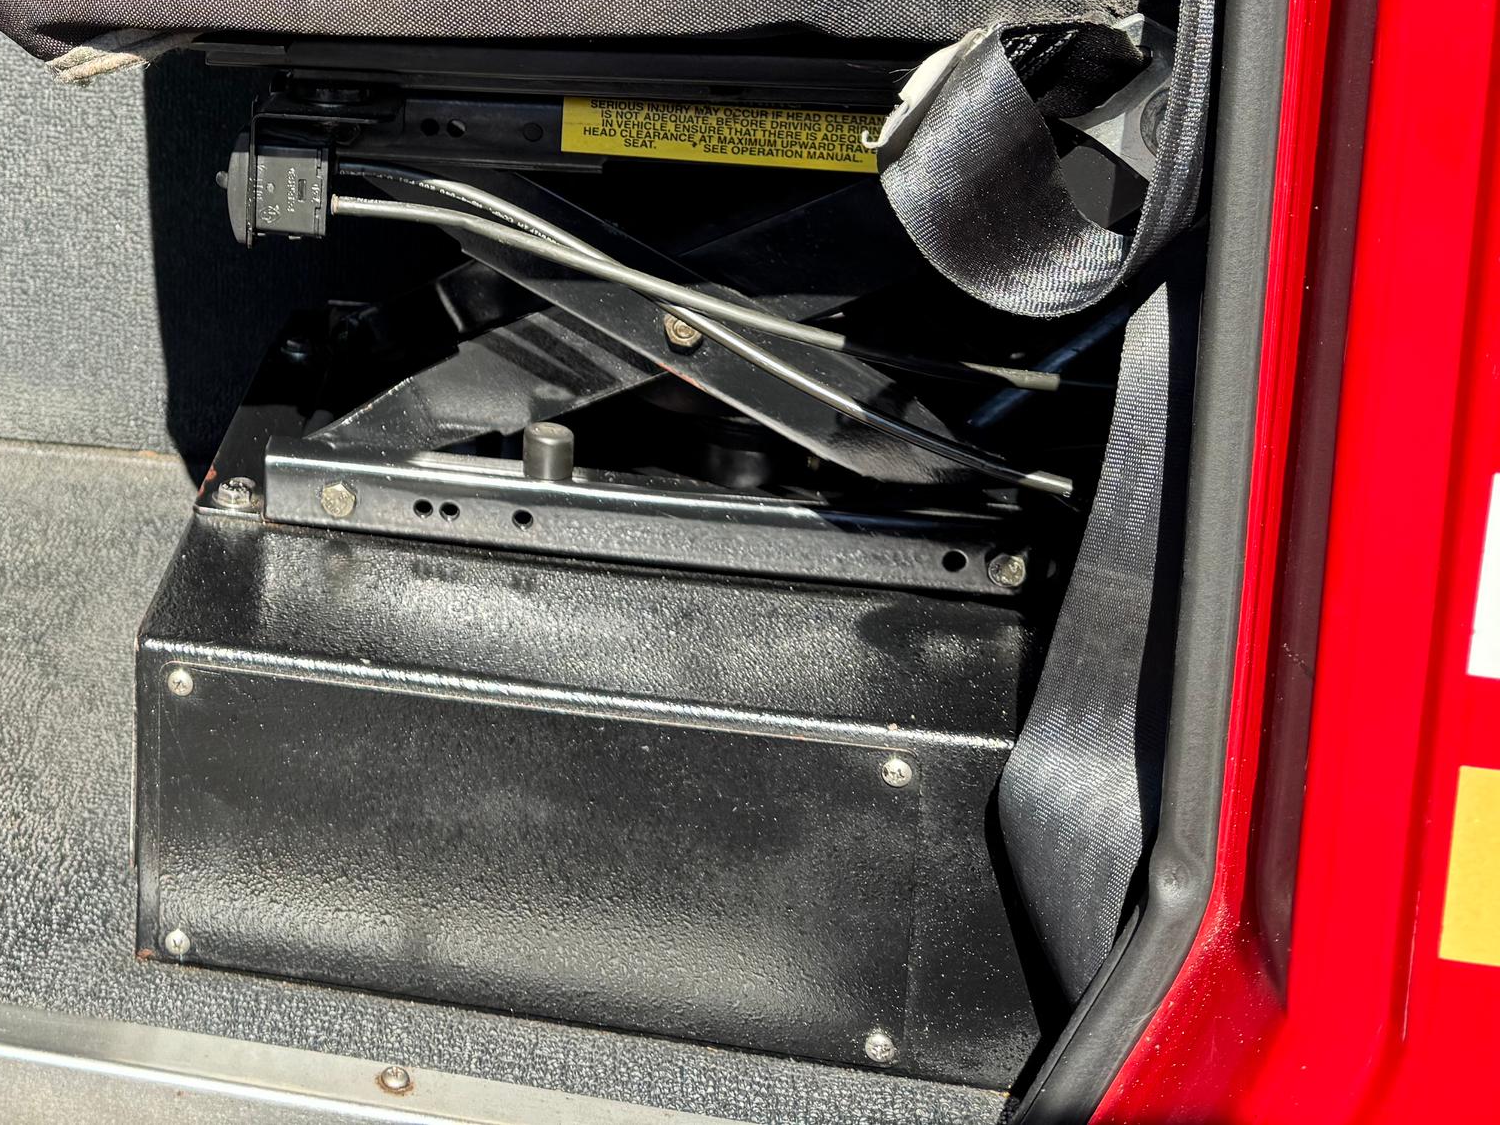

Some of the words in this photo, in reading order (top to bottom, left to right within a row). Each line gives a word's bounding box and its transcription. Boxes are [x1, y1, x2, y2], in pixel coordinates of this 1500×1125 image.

[591, 100, 644, 111] SERIOUS
[647, 101, 691, 114] INJURY
[694, 105, 721, 116] MAY
[723, 107, 768, 119] OCCUR
[771, 109, 783, 119] IF
[786, 112, 821, 123] HEAD
[601, 110, 612, 119] IS
[615, 111, 640, 121] NOT
[716, 117, 766, 129] BEFORE
[770, 120, 821, 132] DRIVING
[825, 123, 843, 133] OR
[583, 127, 617, 137] HEAD
[620, 129, 695, 143] CLEARANCE
[699, 135, 715, 144] AT
[717, 136, 777, 148] MAXIMUM
[781, 140, 836, 152] UPWARD
[601, 119, 613, 128] IN
[674, 124, 724, 136] ENSURE
[726, 127, 759, 138] THAT
[761, 129, 801, 140] THERE
[805, 132, 817, 141] IS
[624, 138, 657, 149] SEAT.
[703, 144, 727, 154] SEE
[731, 145, 803, 159] OPERATION
[806, 151, 863, 163] MANUAL.
